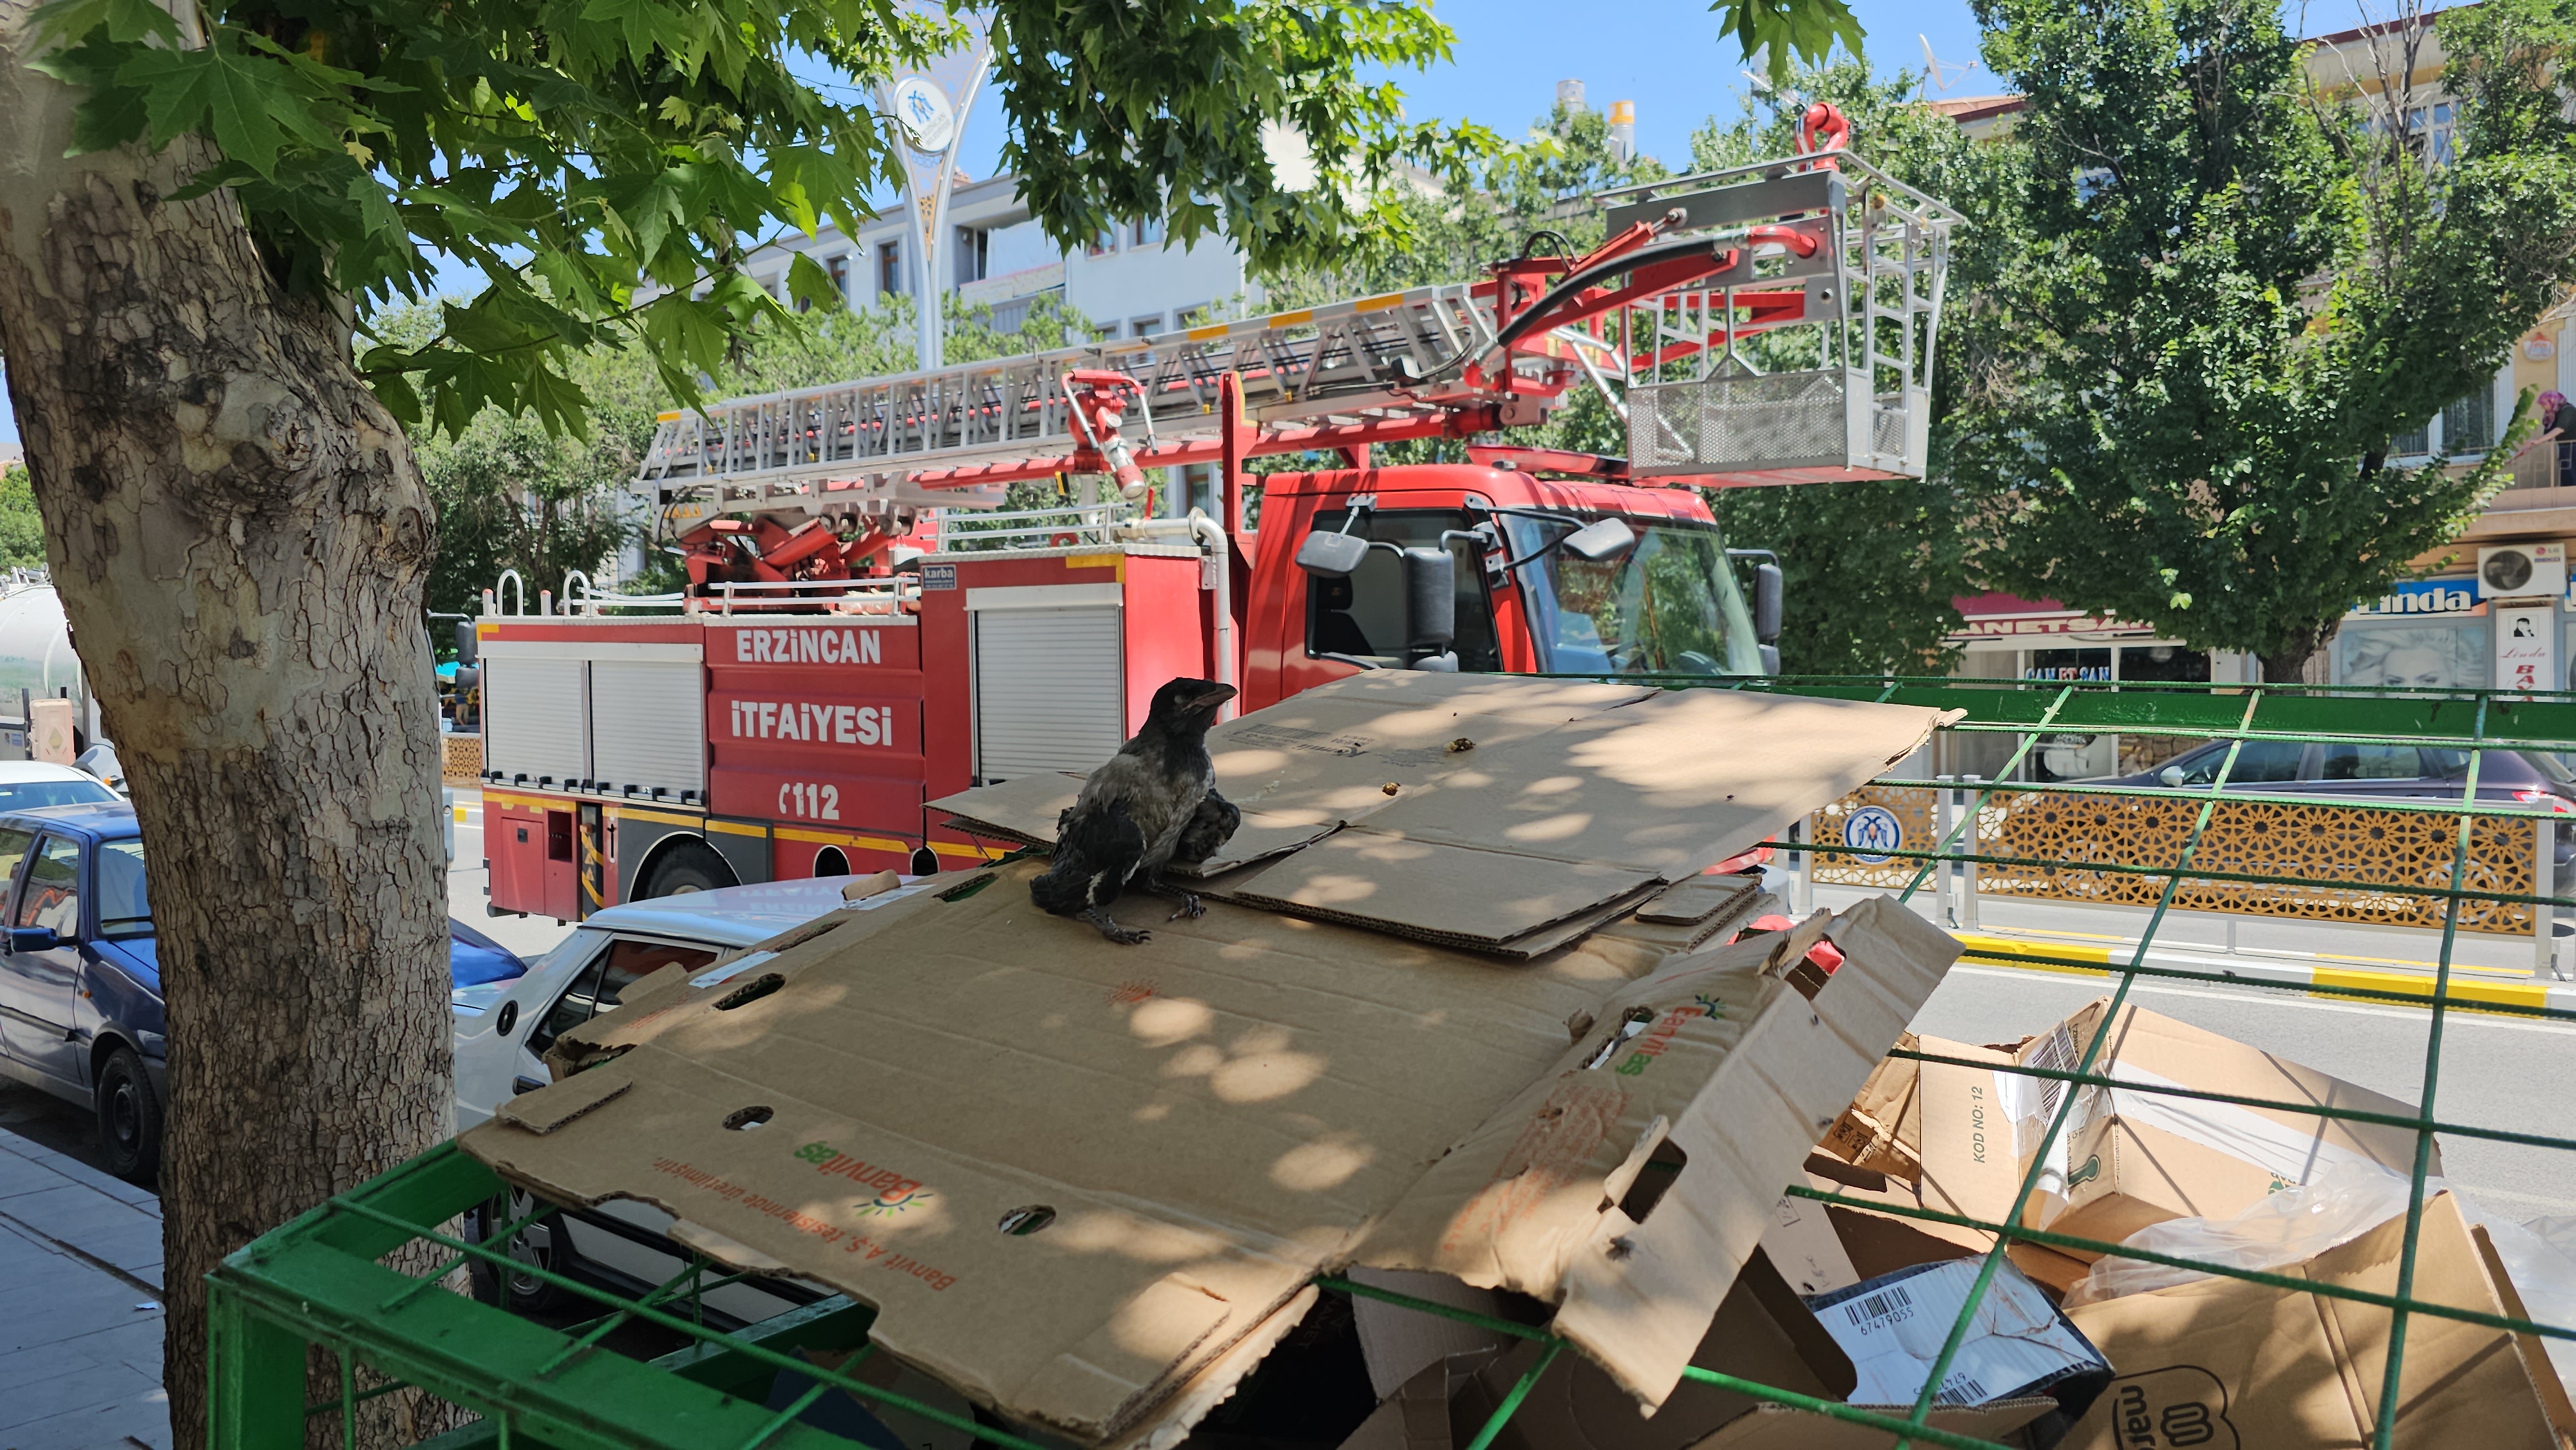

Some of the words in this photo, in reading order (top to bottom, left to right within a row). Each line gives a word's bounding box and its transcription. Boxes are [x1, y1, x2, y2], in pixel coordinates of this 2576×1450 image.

[924, 567, 953, 578] karba
[1948, 617, 2155, 636] ANETSA
[736, 629, 880, 664] ERZİNCAN
[732, 700, 892, 746] İTFAİYESİ
[793, 782, 839, 820] 112
[1972, 1086, 1983, 1102] 12
[1972, 1106, 1984, 1131] NO:
[1973, 1133, 1985, 1163] KOD
[793, 1140, 923, 1202] Banvitaş
[743, 1194, 846, 1244] tesislerinde
[845, 1234, 889, 1261] A.Ş.
[883, 1254, 957, 1292] Banvit
[1861, 1306, 1914, 1336] 67479055
[2121, 1385, 2157, 1450] mar
